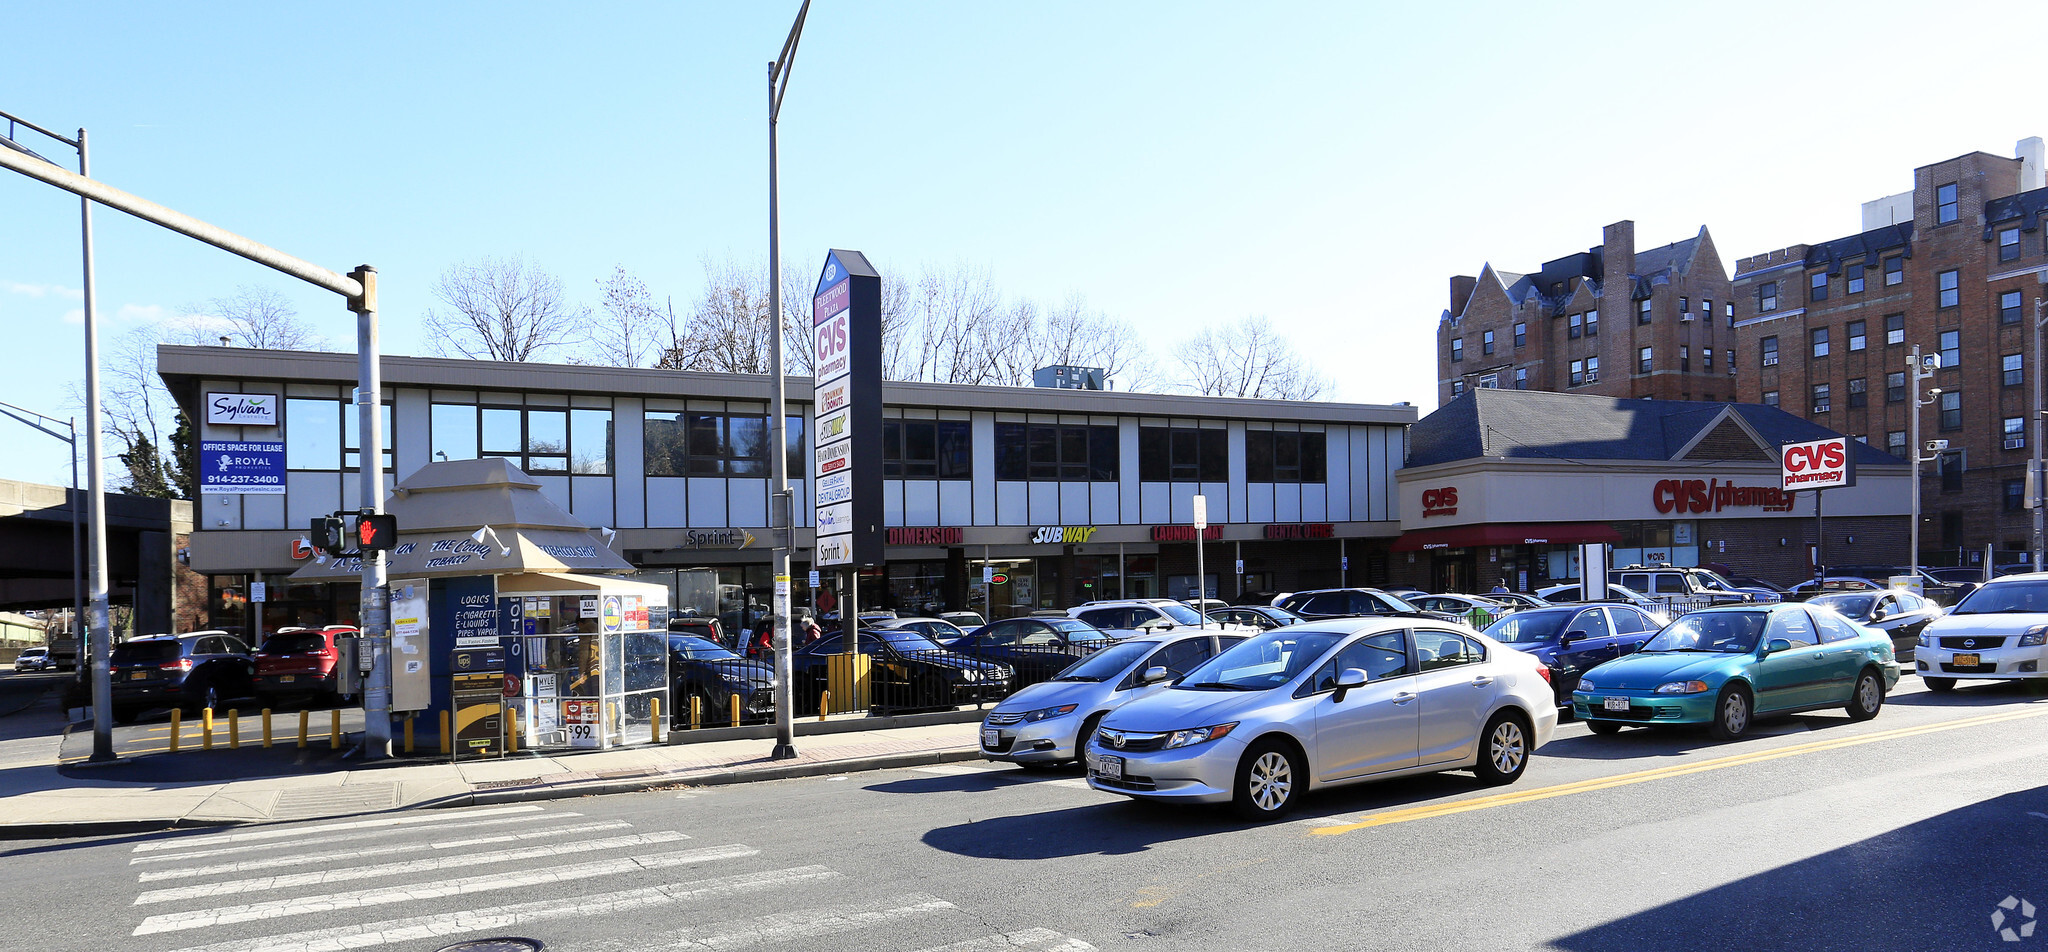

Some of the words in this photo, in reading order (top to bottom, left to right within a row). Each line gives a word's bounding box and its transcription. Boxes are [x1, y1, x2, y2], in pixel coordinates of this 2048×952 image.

[816, 282, 847, 309] FLEETWOOD
[824, 306, 839, 319] PLAZA
[818, 316, 847, 361] CVS
[818, 355, 847, 381] pharmacy
[213, 397, 271, 420] Sylvan
[827, 396, 843, 410] DONUTS
[820, 414, 846, 441] SUBWAY
[203, 443, 226, 451] OFFICE
[227, 444, 248, 452] SPACE
[249, 444, 262, 452] FOR
[262, 444, 283, 452] LEASE
[827, 442, 850, 460] DIMENSION
[235, 457, 271, 466] ROYAL
[1784, 442, 1845, 472] CVS
[208, 475, 279, 484] 914-237-3400
[1785, 471, 1843, 486] pharmacy
[818, 489, 835, 504] DENTAL
[834, 487, 850, 501] GROUP
[1422, 487, 1458, 508] CVS
[1653, 477, 1796, 514] CVS/pharmacy
[687, 529, 734, 549] Sprint
[888, 527, 963, 544] DIMENSION
[1032, 526, 1097, 544] SUBWAY
[1151, 525, 1225, 540] LAUNDRMAT
[1266, 525, 1301, 539] DENTAL
[1303, 524, 1335, 538] OFFICE
[395, 543, 417, 555] ON
[429, 539, 456, 552] THE
[452, 539, 491, 560] Corner
[575, 545, 597, 558] SHOP
[821, 543, 840, 566] Sprint
[1653, 552, 1665, 560] CVS
[425, 554, 471, 568] TOBACCO
[461, 595, 490, 604] LOGICS
[455, 619, 489, 629] E-LIQUIDS
[457, 629, 474, 637] PIPES
[460, 658, 470, 667] ups
